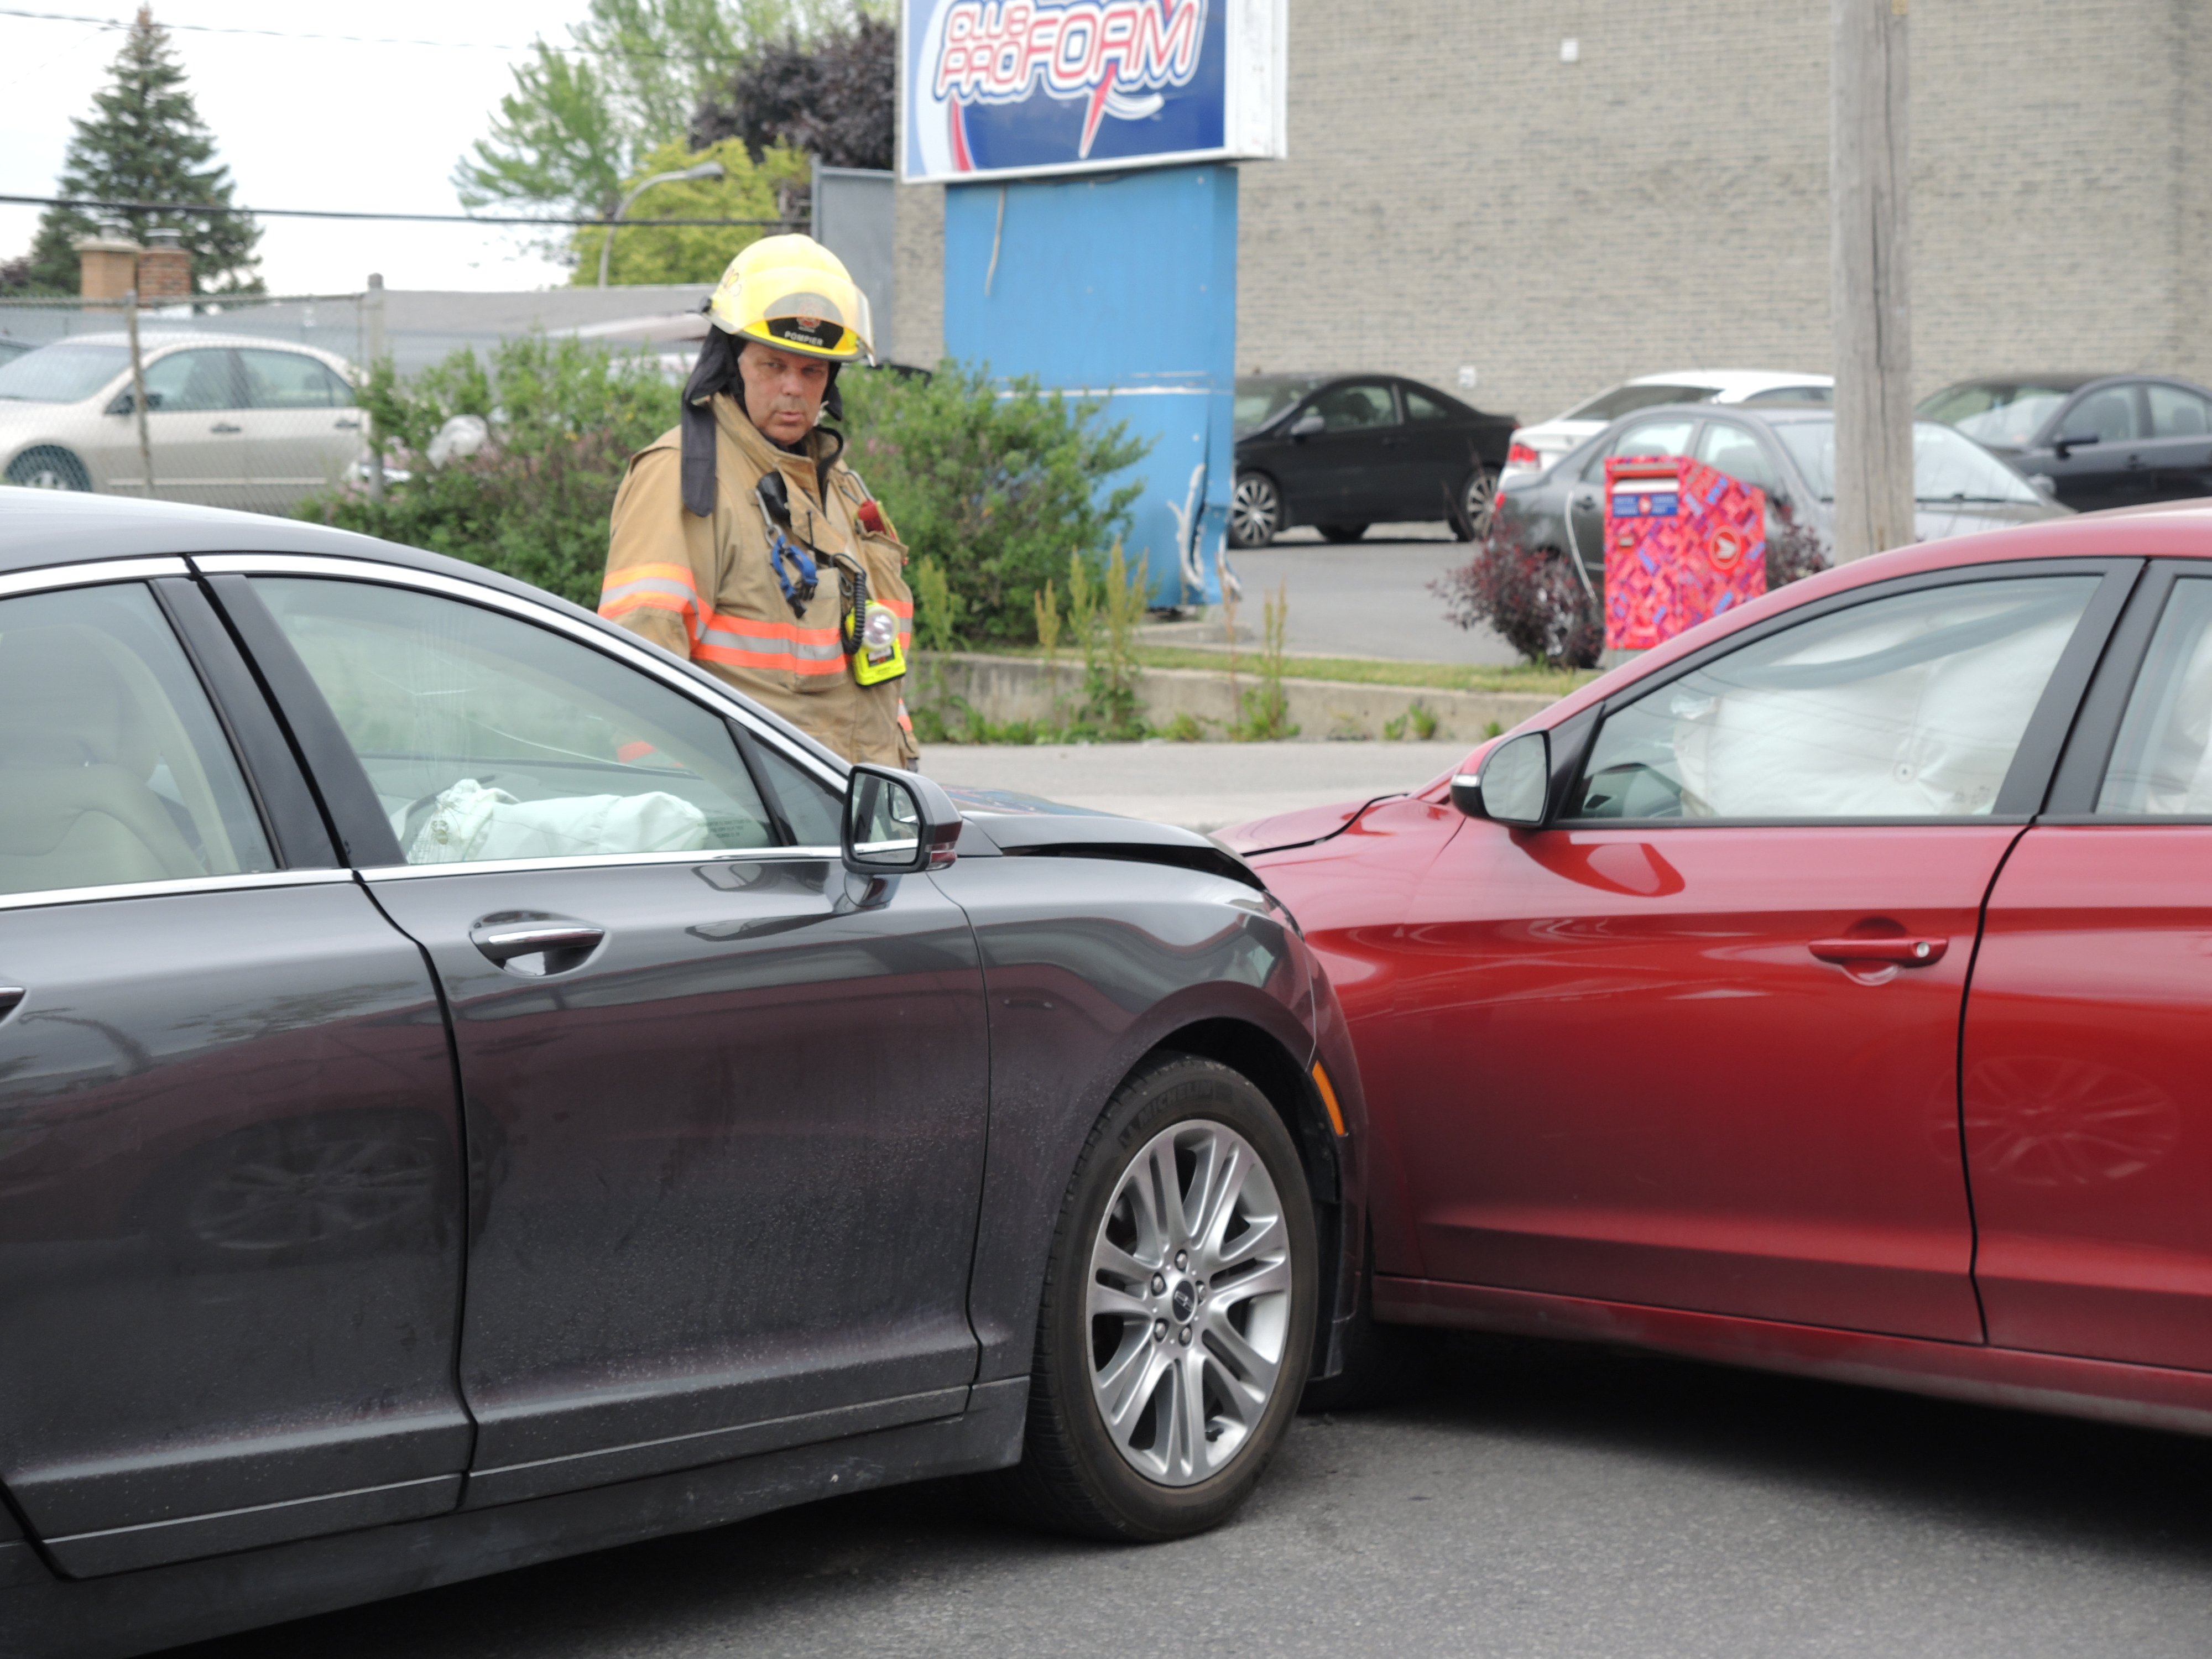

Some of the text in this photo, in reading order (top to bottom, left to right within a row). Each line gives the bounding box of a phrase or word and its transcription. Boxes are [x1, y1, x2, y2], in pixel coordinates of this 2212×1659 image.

[945, 1, 1032, 45] CLUB
[784, 331, 823, 346] POMPIER
[1137, 1079, 1213, 1127] MICHELIN
